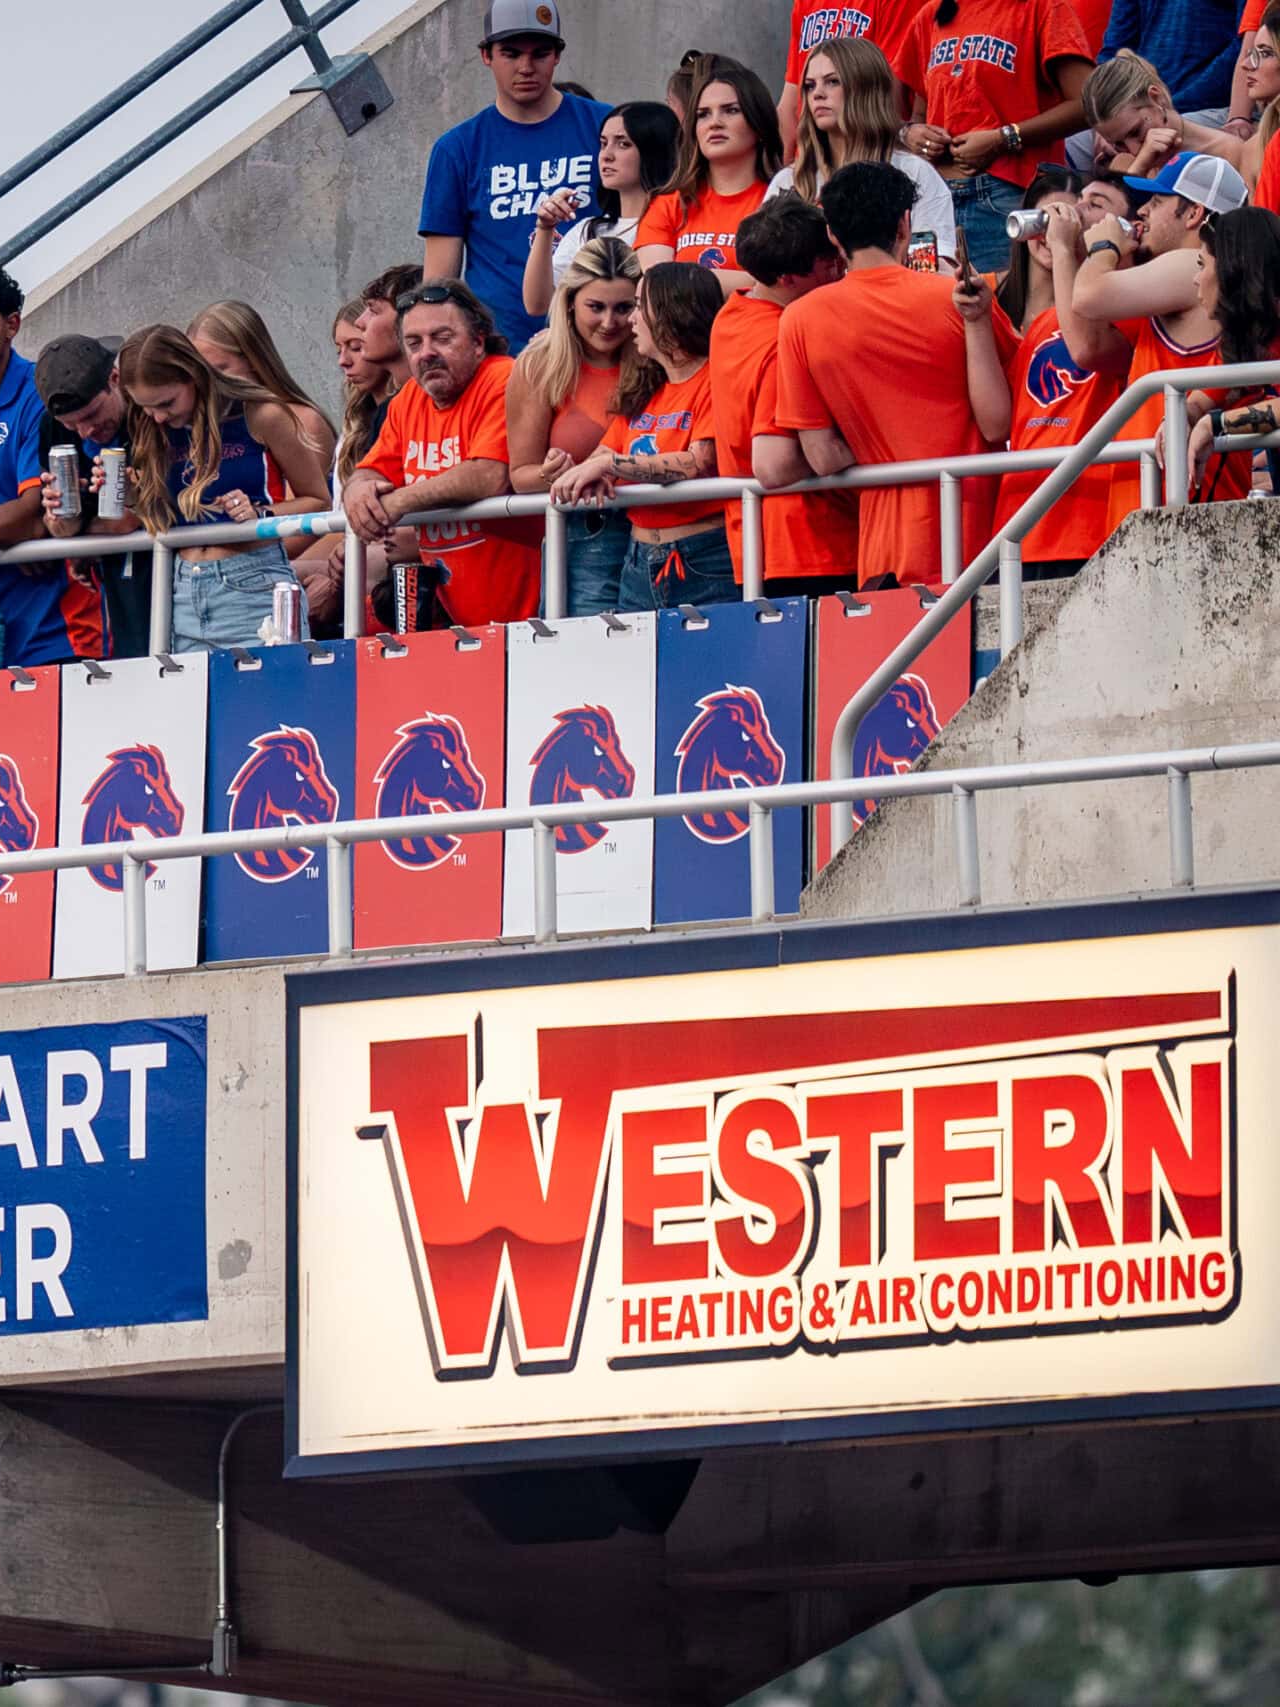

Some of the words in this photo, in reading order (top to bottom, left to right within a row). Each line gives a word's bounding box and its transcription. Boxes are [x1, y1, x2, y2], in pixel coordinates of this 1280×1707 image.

[959, 34, 1017, 73] STATE
[491, 155, 592, 195] BLUE
[395, 567, 407, 635] RONCOS
[452, 854, 467, 866] TM
[603, 842, 618, 854] TM
[152, 879, 167, 892] TM
[305, 867, 320, 879] TM
[4, 891, 19, 904] TM
[369, 990, 1223, 1357] WESTERN
[621, 1286, 794, 1345] HEATING
[809, 1284, 836, 1331] &
[848, 1275, 918, 1327] AIR
[930, 1250, 1228, 1318] CONDITIONING
